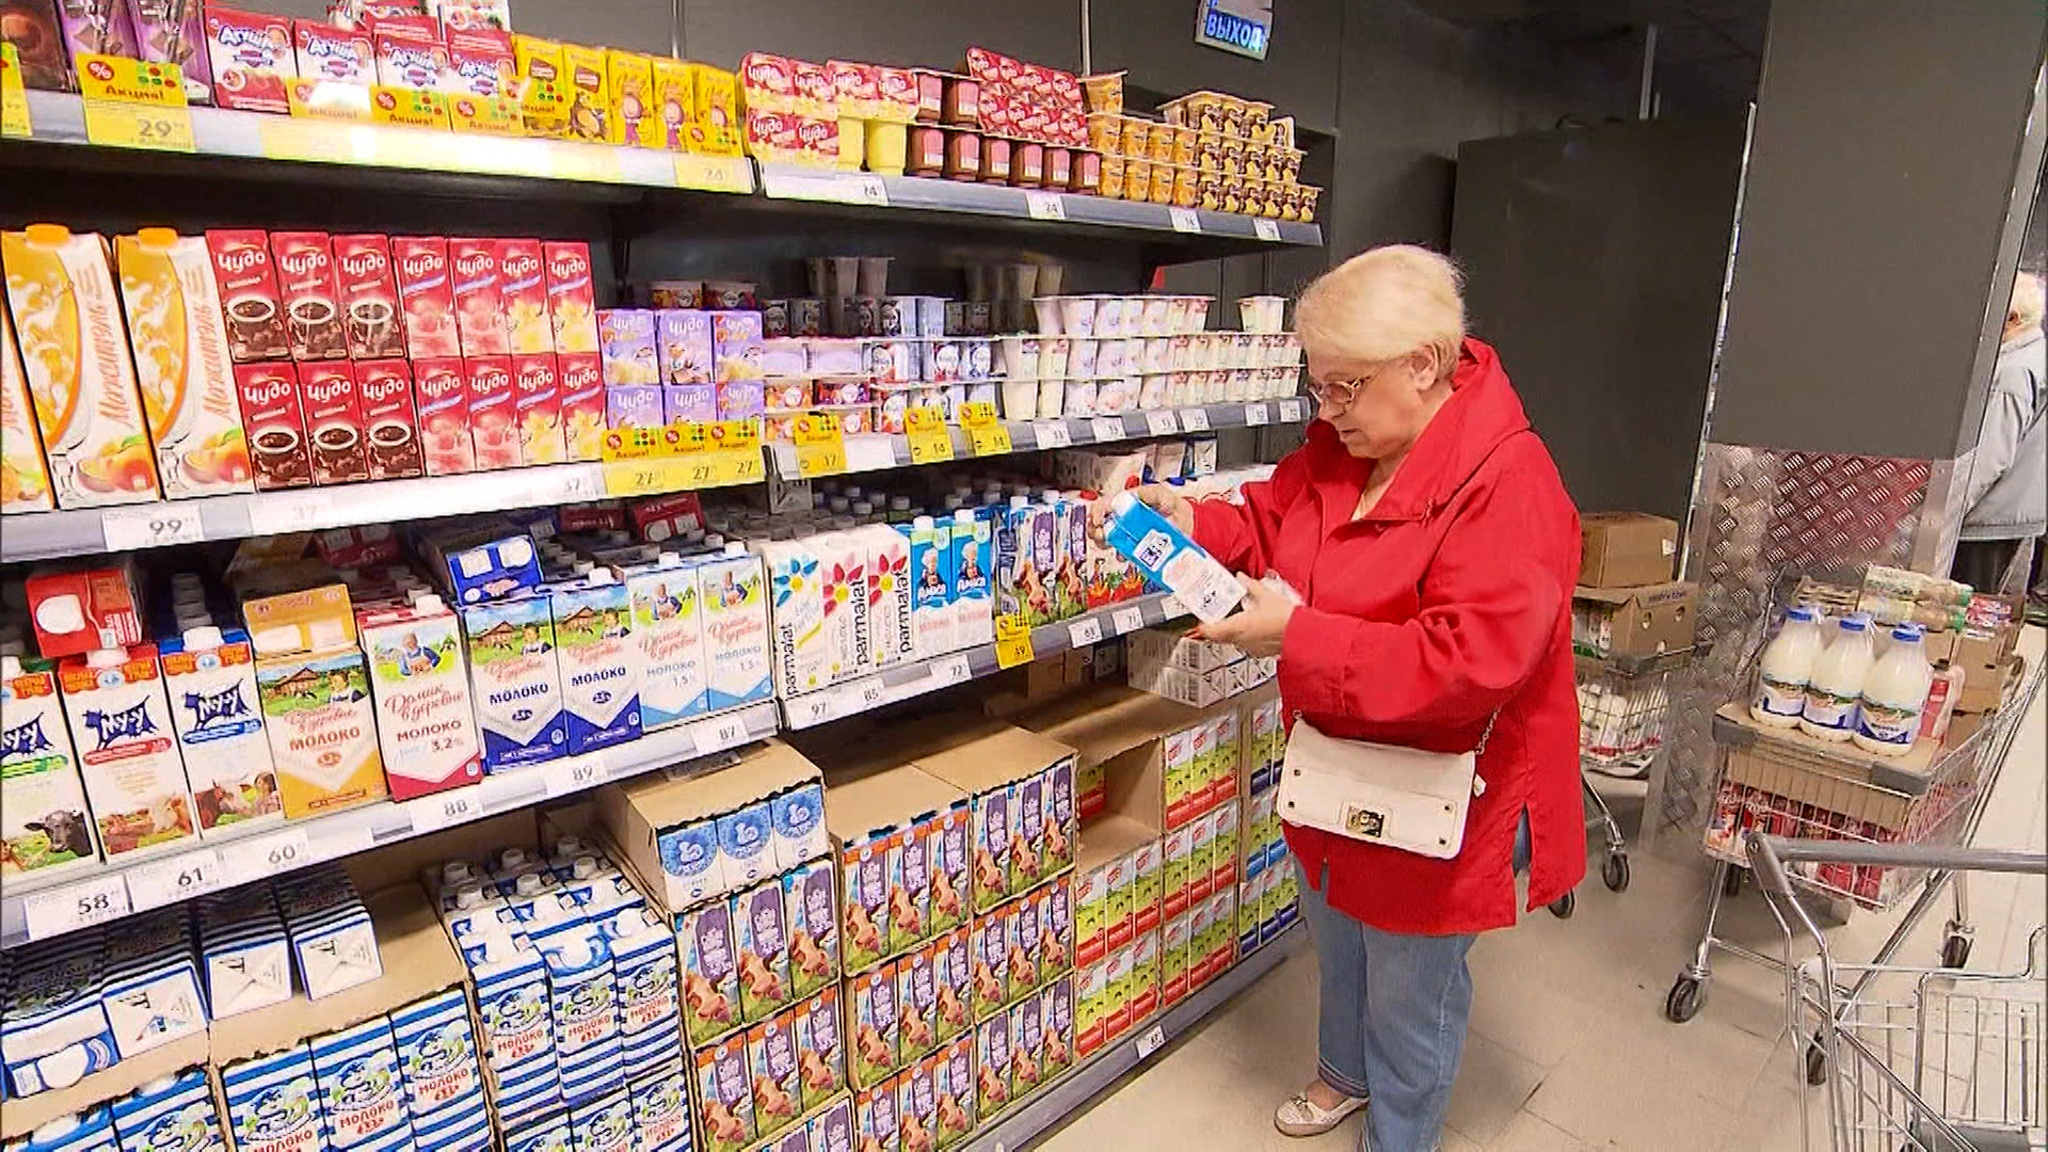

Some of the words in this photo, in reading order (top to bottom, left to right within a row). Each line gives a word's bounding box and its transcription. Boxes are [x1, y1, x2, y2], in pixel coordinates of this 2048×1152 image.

[1206, 14, 1265, 53] ВЫХОД
[105, 84, 164, 100] Акция!
[138, 119, 172, 137] 29
[753, 118, 783, 138] Чудо
[798, 125, 828, 143] Чудо
[218, 250, 265, 273] Чудо
[281, 253, 327, 275] Чудо
[342, 255, 386, 277] Чудо
[403, 255, 443, 277] Чудо
[456, 255, 493, 276] Чудо
[502, 255, 538, 276] Чудо
[551, 257, 586, 278] Чудо
[669, 318, 703, 334] Чудо
[362, 378, 404, 402] Чудо
[421, 374, 461, 396] Чудо
[471, 374, 509, 394] Чудо
[518, 370, 554, 391] Чудо
[564, 369, 599, 390] Чудо
[244, 381, 291, 405] Чудо
[307, 380, 351, 403] Чудо
[617, 390, 655, 409] Чудо
[674, 390, 710, 409] Чудо
[693, 466, 710, 480] 27
[737, 461, 752, 475] 27
[635, 472, 654, 486] 27
[149, 518, 183, 537] 99
[894, 568, 913, 653] parmalat
[850, 579, 870, 666] parmalat
[780, 623, 799, 697] parmalat
[571, 666, 627, 687] МОЛОКО
[489, 683, 549, 706] МОЛОКО
[811, 702, 827, 716] 97
[289, 726, 361, 751] МОЛОКО
[573, 767, 594, 782] 89
[268, 844, 296, 864] 60
[178, 867, 204, 887] 61
[77, 893, 110, 915] 58
[419, 1066, 469, 1094] МОЛОКО
[340, 1100, 395, 1128] МОЛОКО
